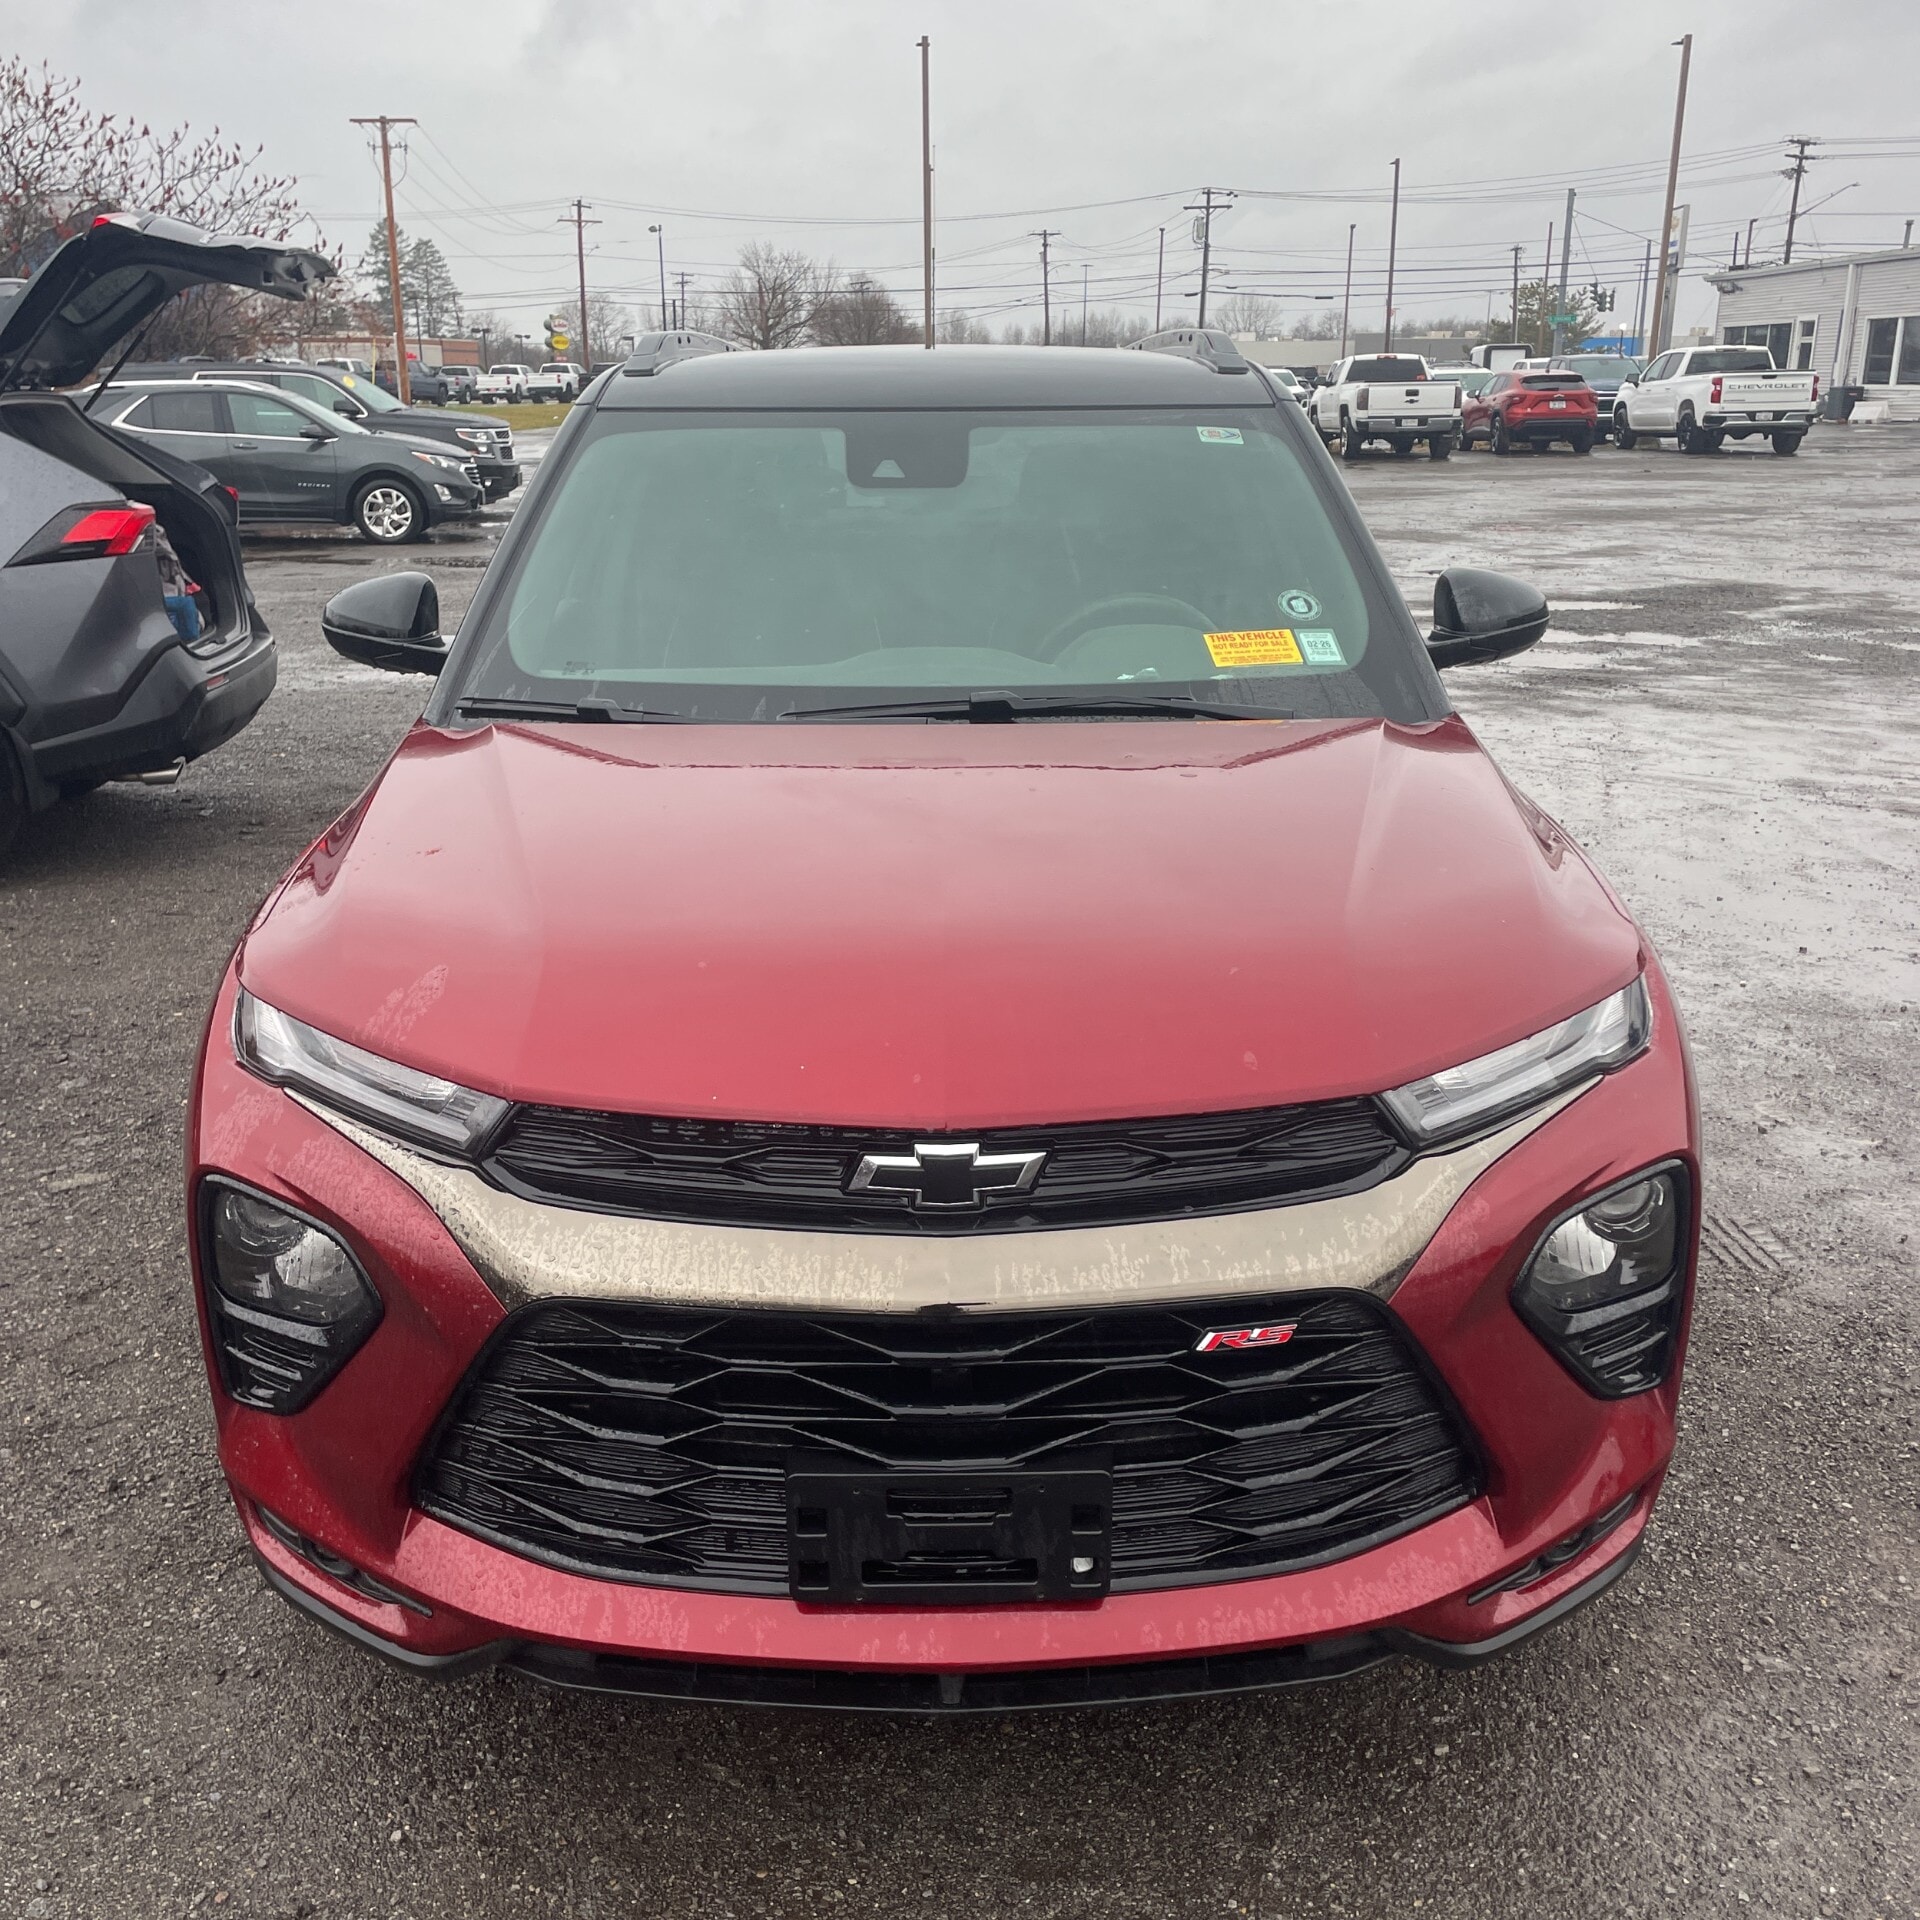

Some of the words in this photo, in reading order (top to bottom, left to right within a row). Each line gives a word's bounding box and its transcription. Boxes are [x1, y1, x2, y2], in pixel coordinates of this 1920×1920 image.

[1209, 633, 1237, 643] THIS
[1237, 631, 1287, 641] VEHICLE
[1229, 641, 1253, 649] READY
[1254, 640, 1270, 648] FOR
[1271, 639, 1289, 647] SALE
[1196, 1324, 1298, 1352] RS
